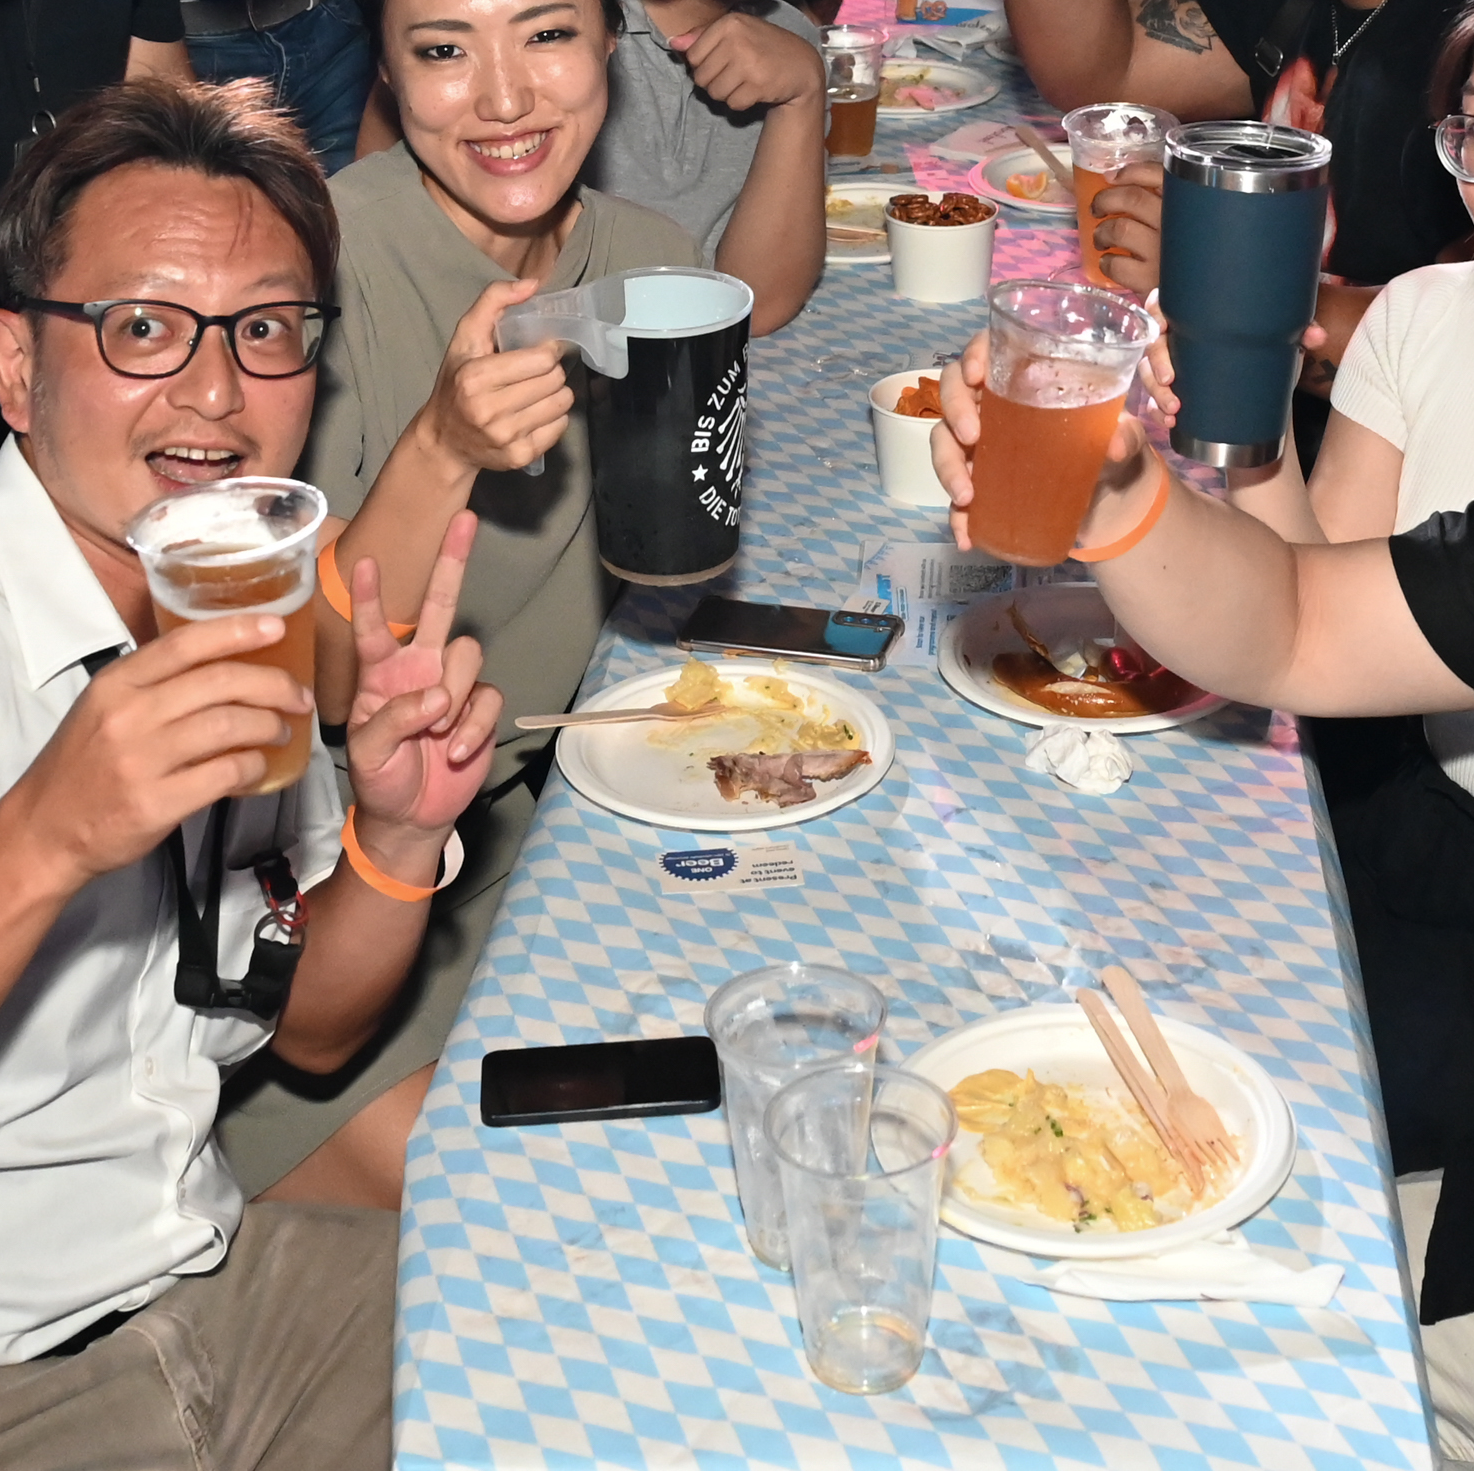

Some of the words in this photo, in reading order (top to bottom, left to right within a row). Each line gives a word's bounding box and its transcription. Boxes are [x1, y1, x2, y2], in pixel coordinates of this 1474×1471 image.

[691, 415, 716, 453] BIS
[707, 360, 741, 411] ZUM
[699, 485, 727, 521] DIE
[675, 858, 724, 867] Beer
[752, 860, 794, 868] redeem
[690, 866, 713, 874] ONE
[764, 867, 795, 875] event
[754, 874, 797, 884] Present
